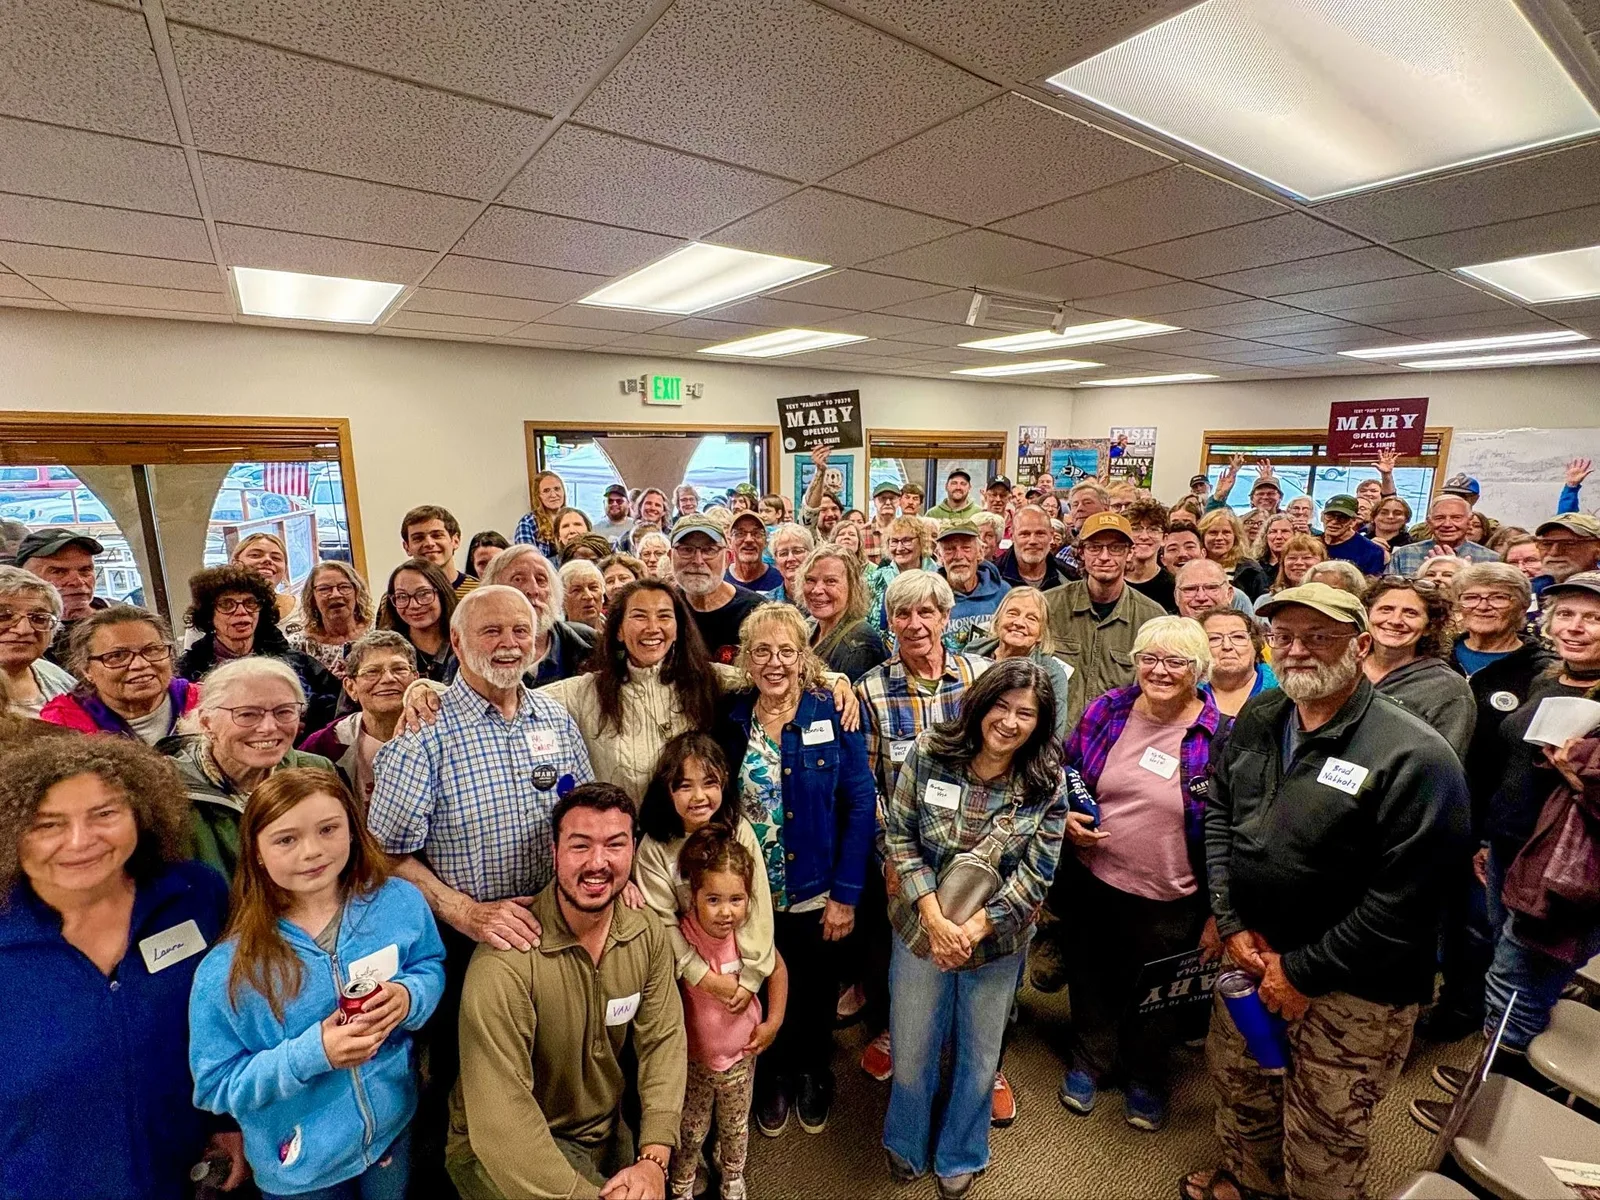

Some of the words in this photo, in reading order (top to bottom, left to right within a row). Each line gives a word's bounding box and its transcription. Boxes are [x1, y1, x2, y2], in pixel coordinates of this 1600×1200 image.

[653, 376, 681, 400] EXIT
[785, 405, 853, 428] MARY
[1335, 413, 1419, 431] MARY
[802, 426, 839, 436] @PELTOLA
[1020, 427, 1046, 439] FISH
[1112, 428, 1155, 440] FISH
[1019, 457, 1043, 465] FAMILY
[1110, 458, 1151, 466] FAMILY
[1332, 765, 1355, 776] Brad
[153, 942, 185, 962] Laura
[1139, 972, 1219, 1006] ARY
[613, 1002, 632, 1017] VAN
